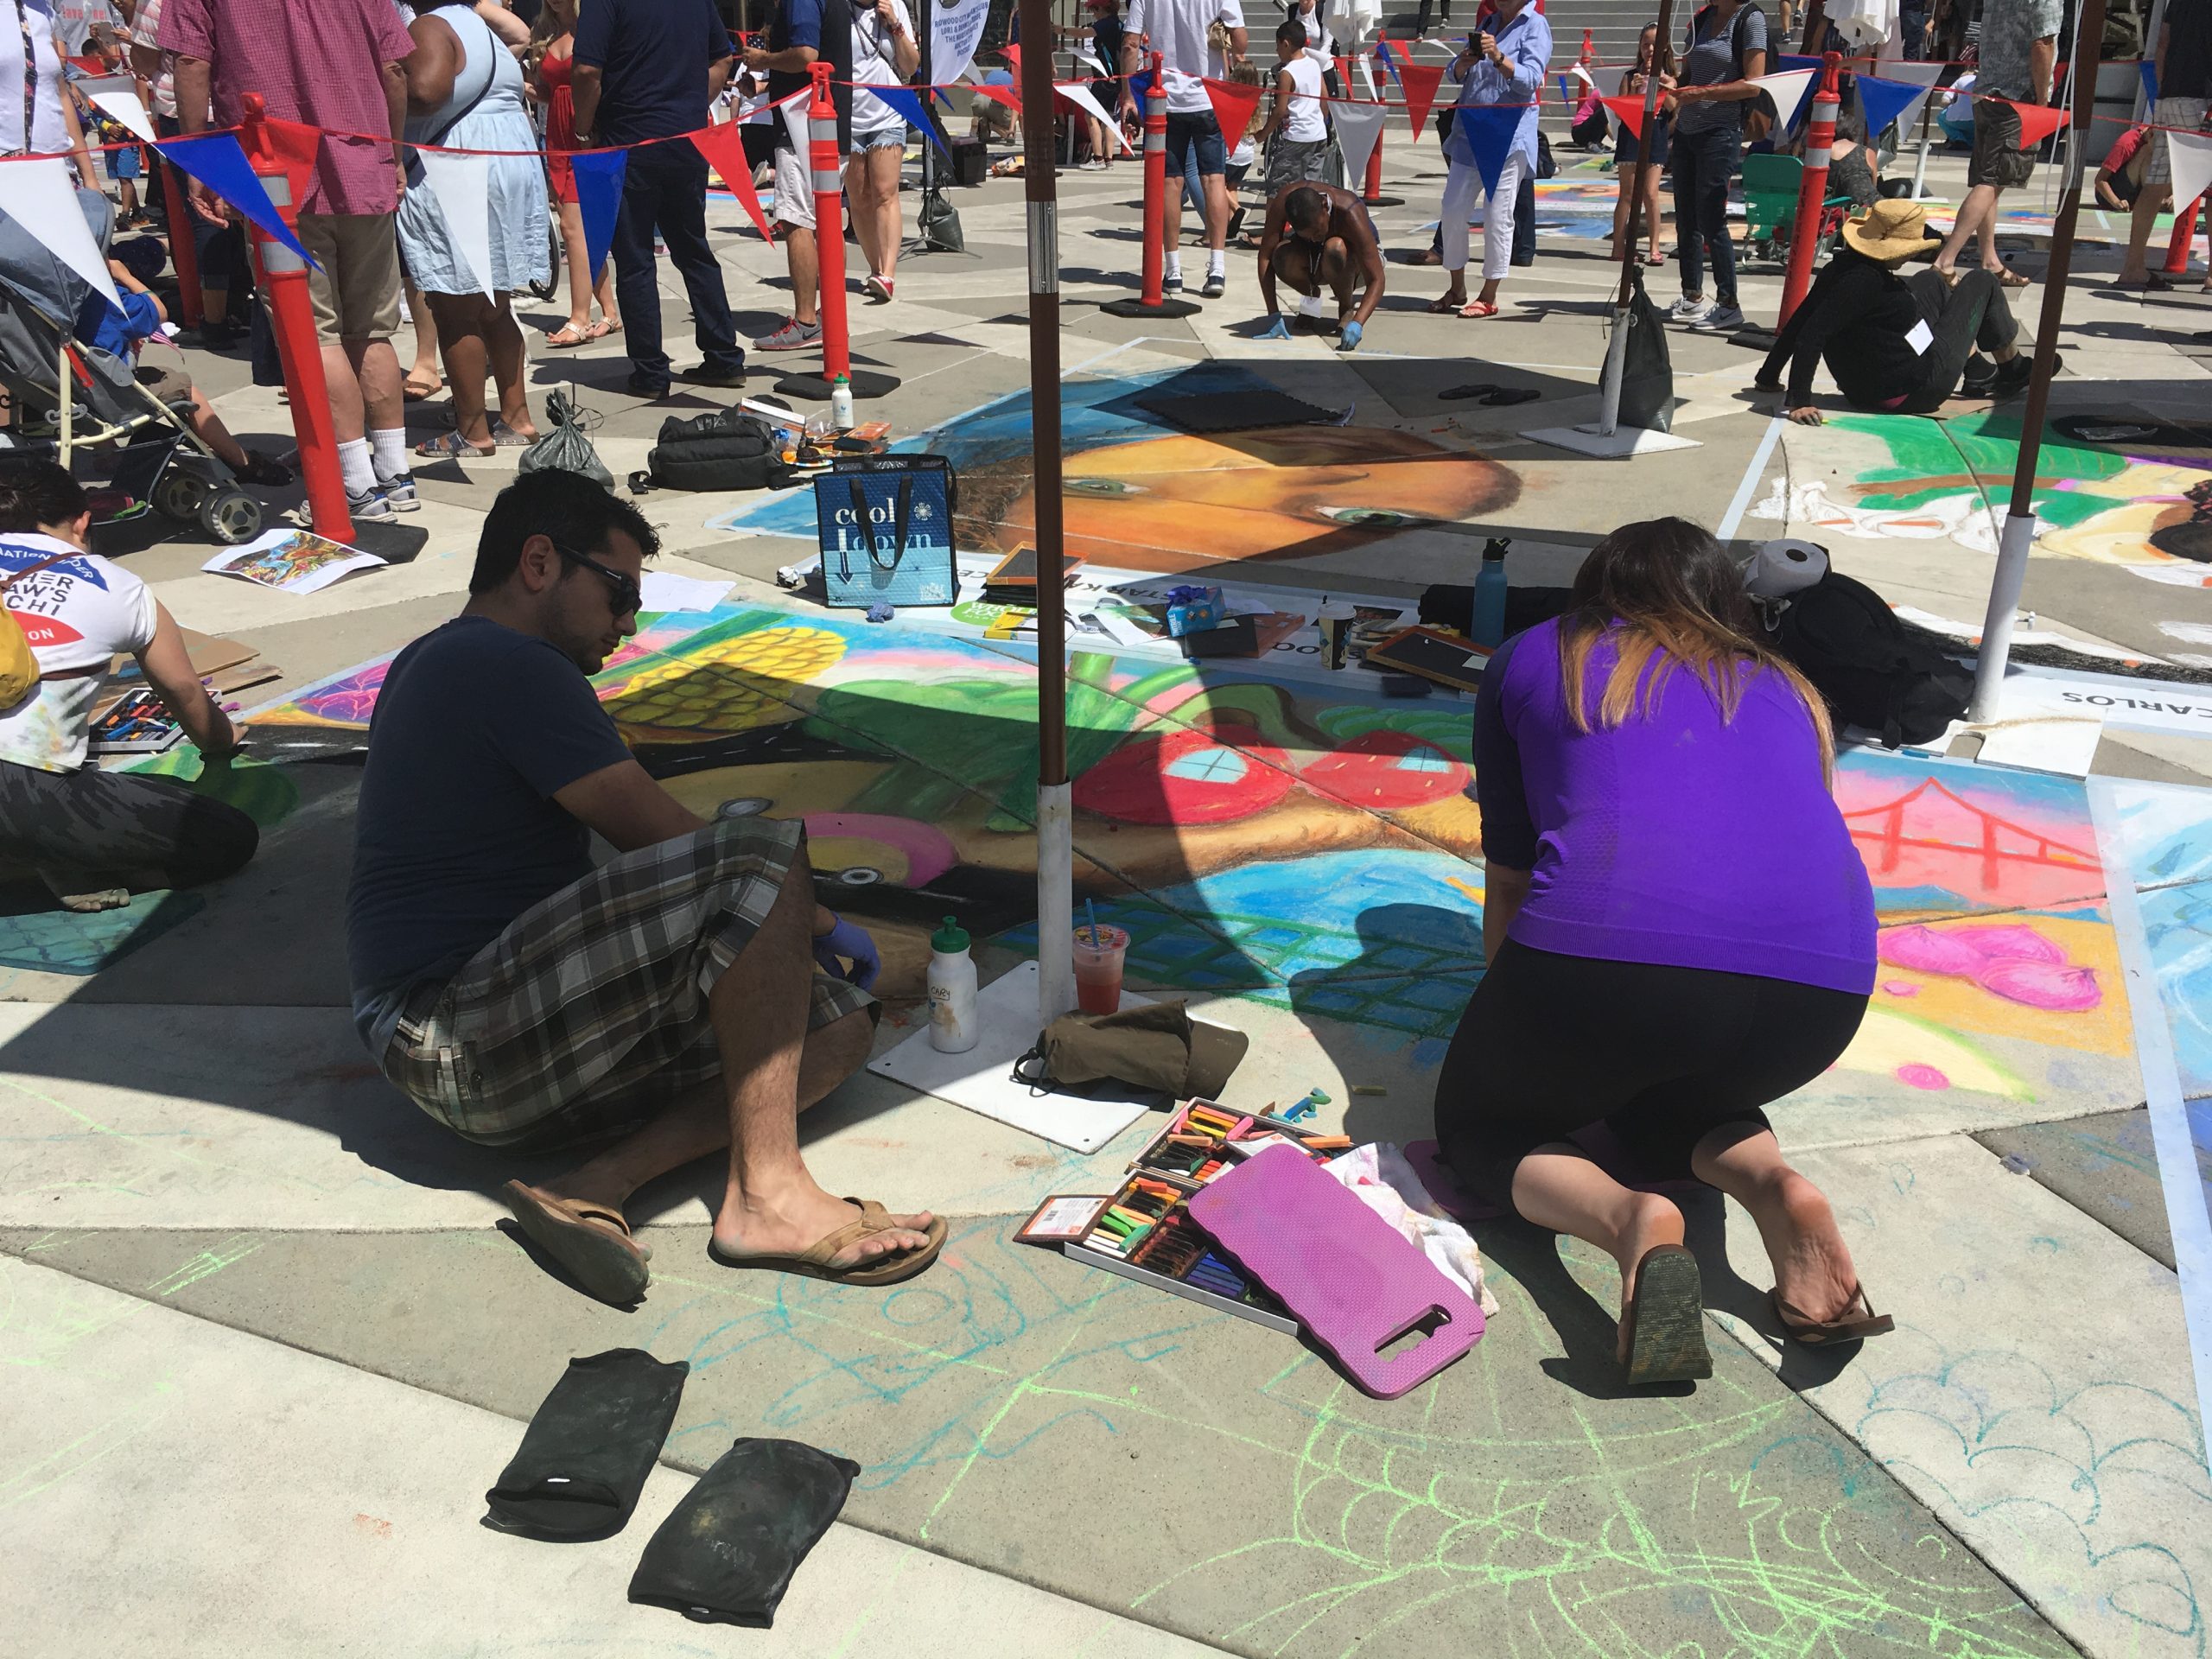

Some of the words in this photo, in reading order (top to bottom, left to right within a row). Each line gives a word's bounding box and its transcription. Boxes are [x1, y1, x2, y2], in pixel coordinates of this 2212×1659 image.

[934, 16, 959, 28] RDWOOD
[941, 25, 953, 35] LORI
[945, 34, 956, 43] THE
[57, 556, 93, 579] PER
[6, 571, 74, 590] HER
[6, 594, 60, 616] CHI
[27, 627, 54, 640] ON
[931, 986, 950, 999] CARY
